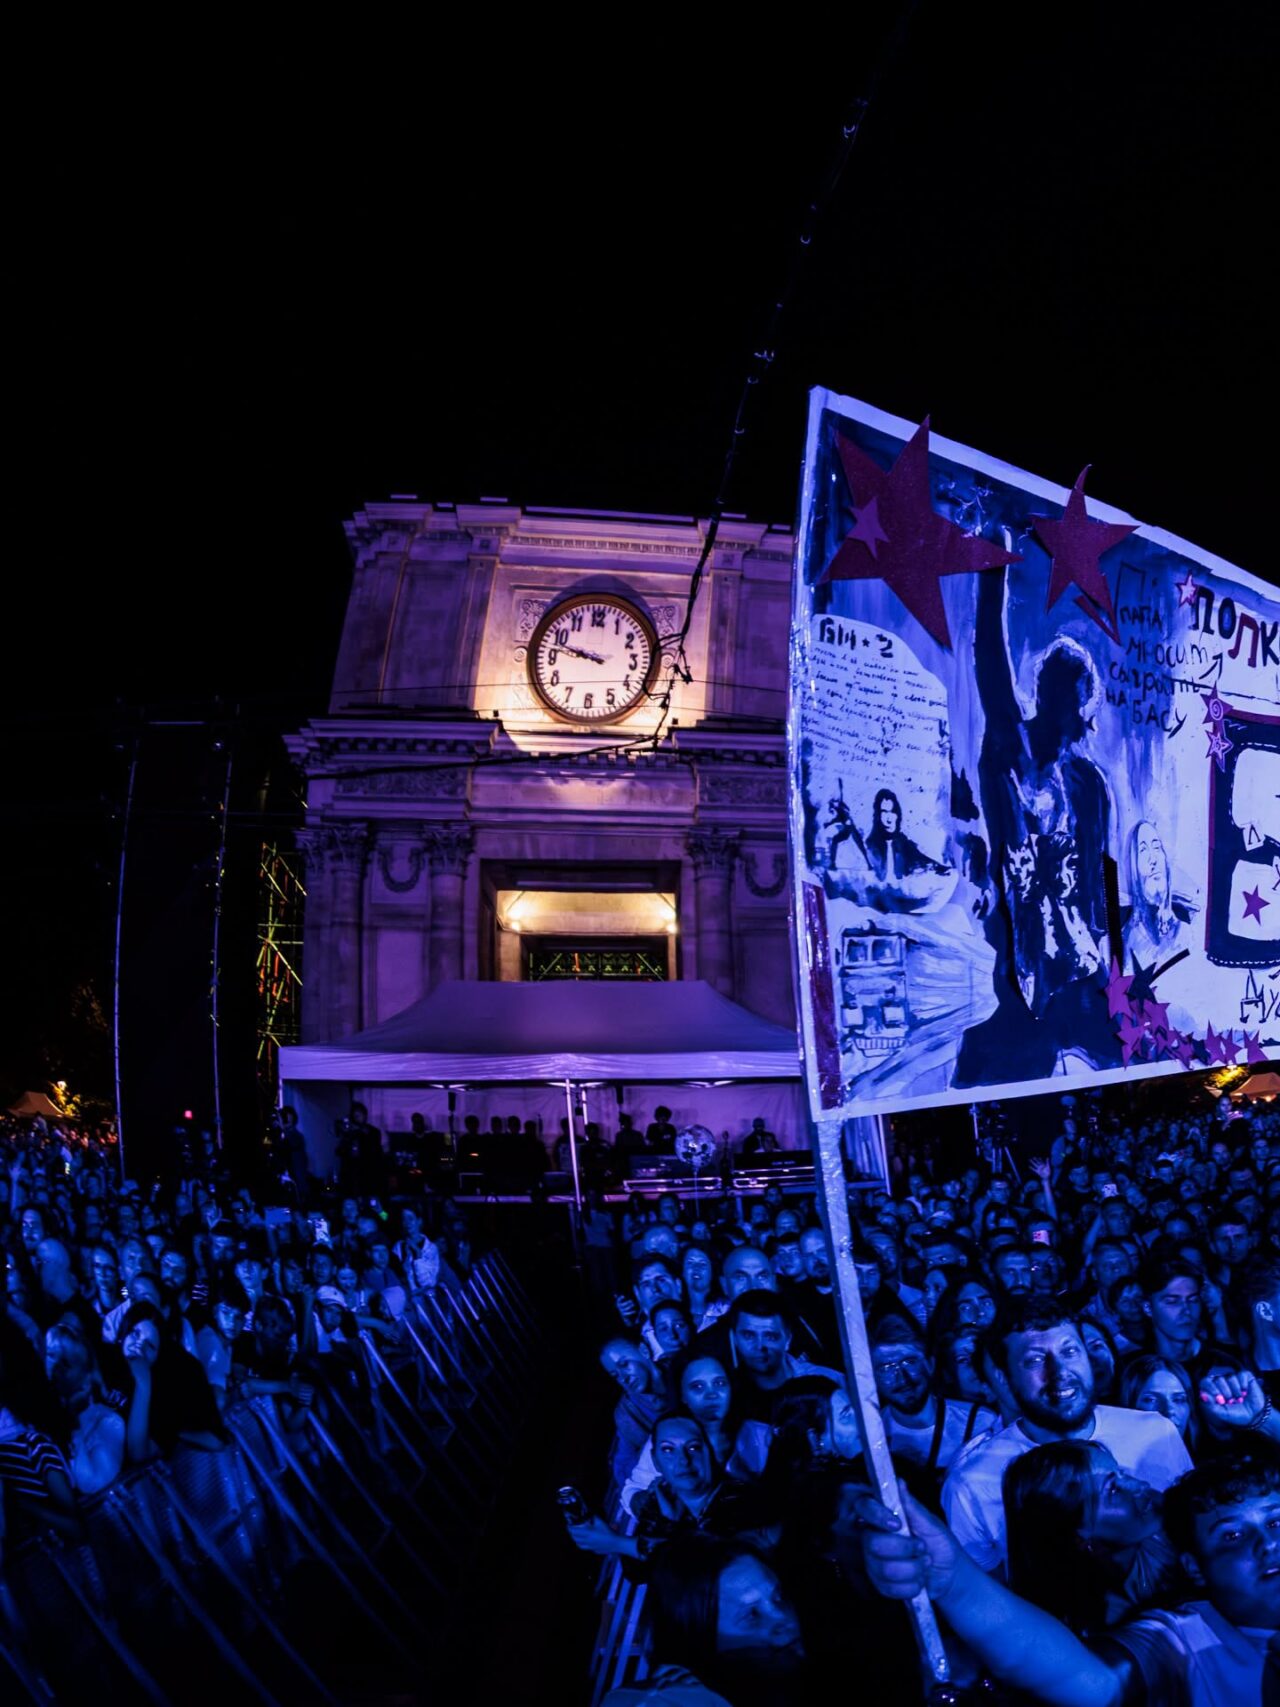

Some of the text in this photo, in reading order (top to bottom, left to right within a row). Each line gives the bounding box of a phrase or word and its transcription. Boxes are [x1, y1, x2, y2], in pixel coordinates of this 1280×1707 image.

[571, 615, 583, 632] 11
[591, 611, 605, 627] 12
[614, 618, 620, 635] 1
[554, 628, 569, 646] 10
[625, 633, 635, 650] 2
[548, 649, 557, 666] 9
[629, 654, 638, 670] 3
[551, 670, 560, 687] 8
[623, 674, 631, 691] 4
[564, 687, 574, 703] 7
[584, 693, 593, 709] 6
[606, 688, 616, 705] 5
